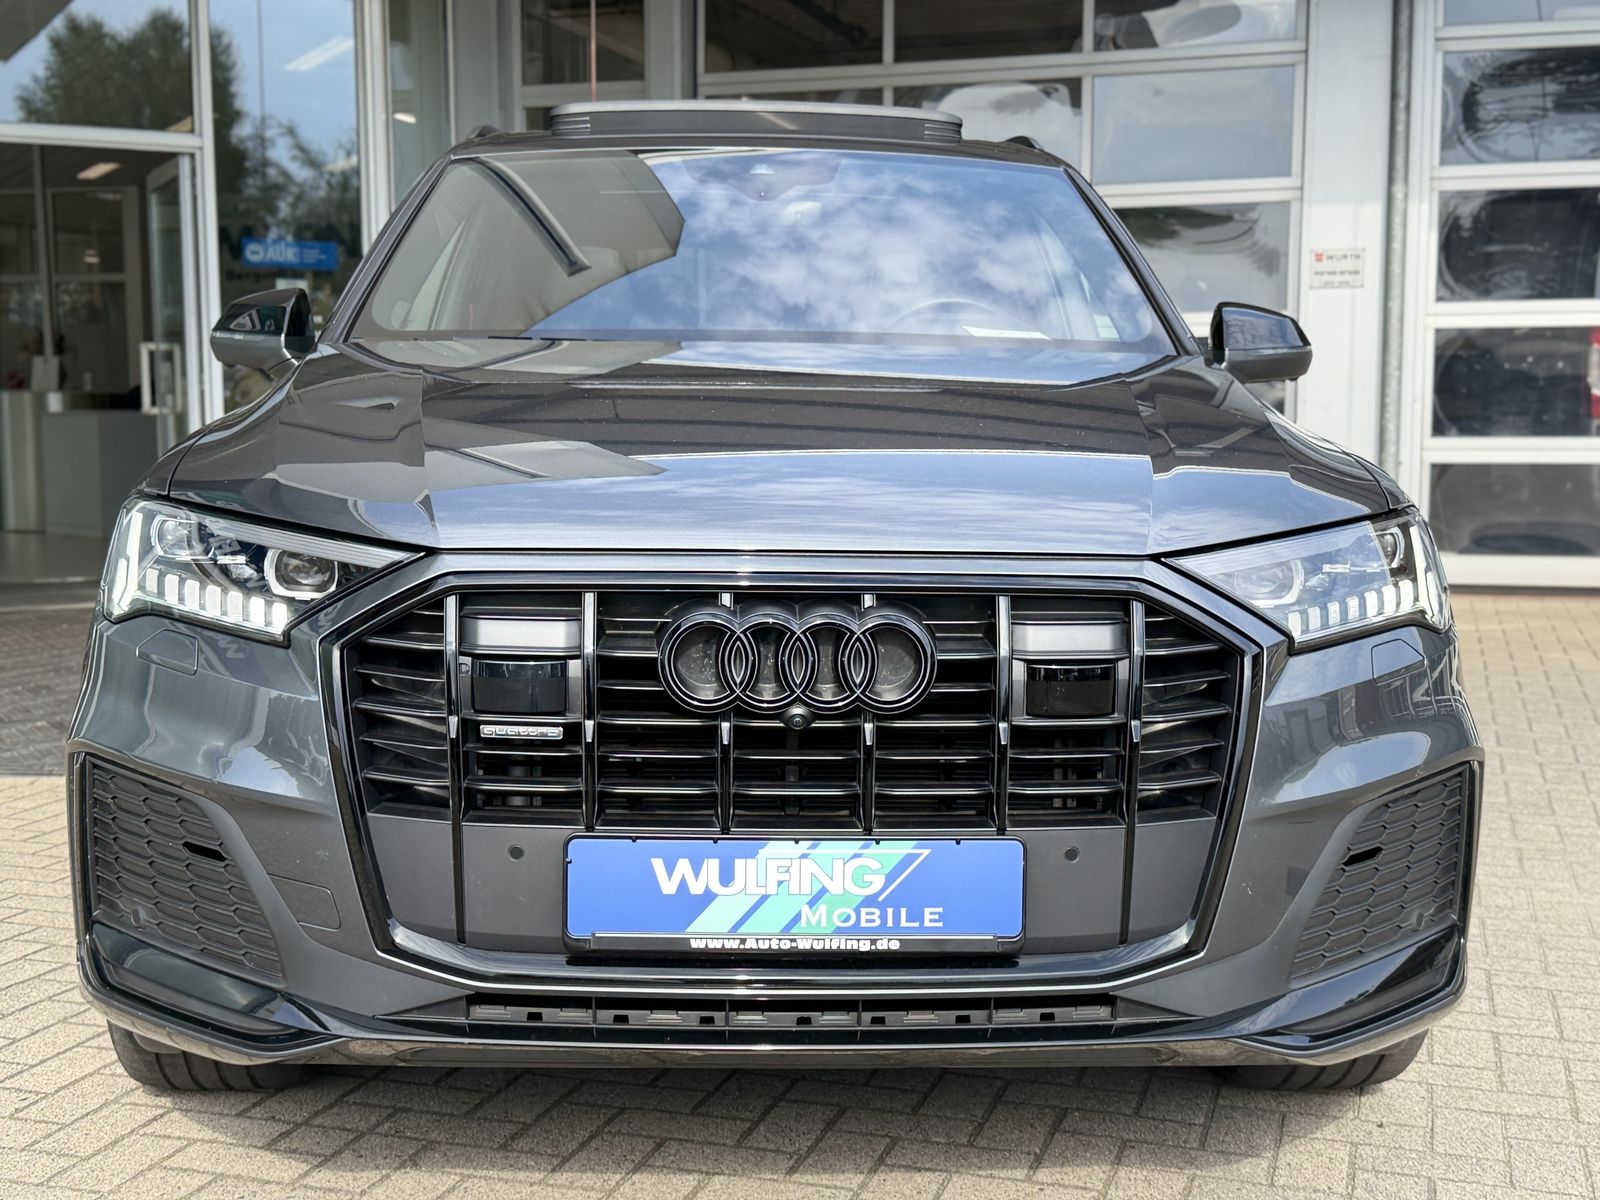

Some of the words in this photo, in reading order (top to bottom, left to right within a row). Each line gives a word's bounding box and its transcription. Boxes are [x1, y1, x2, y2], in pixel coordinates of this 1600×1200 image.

[651, 857, 886, 896] WULFING
[800, 904, 944, 928] MOBILE
[690, 937, 901, 951] www.Auto-Wulfing.de
